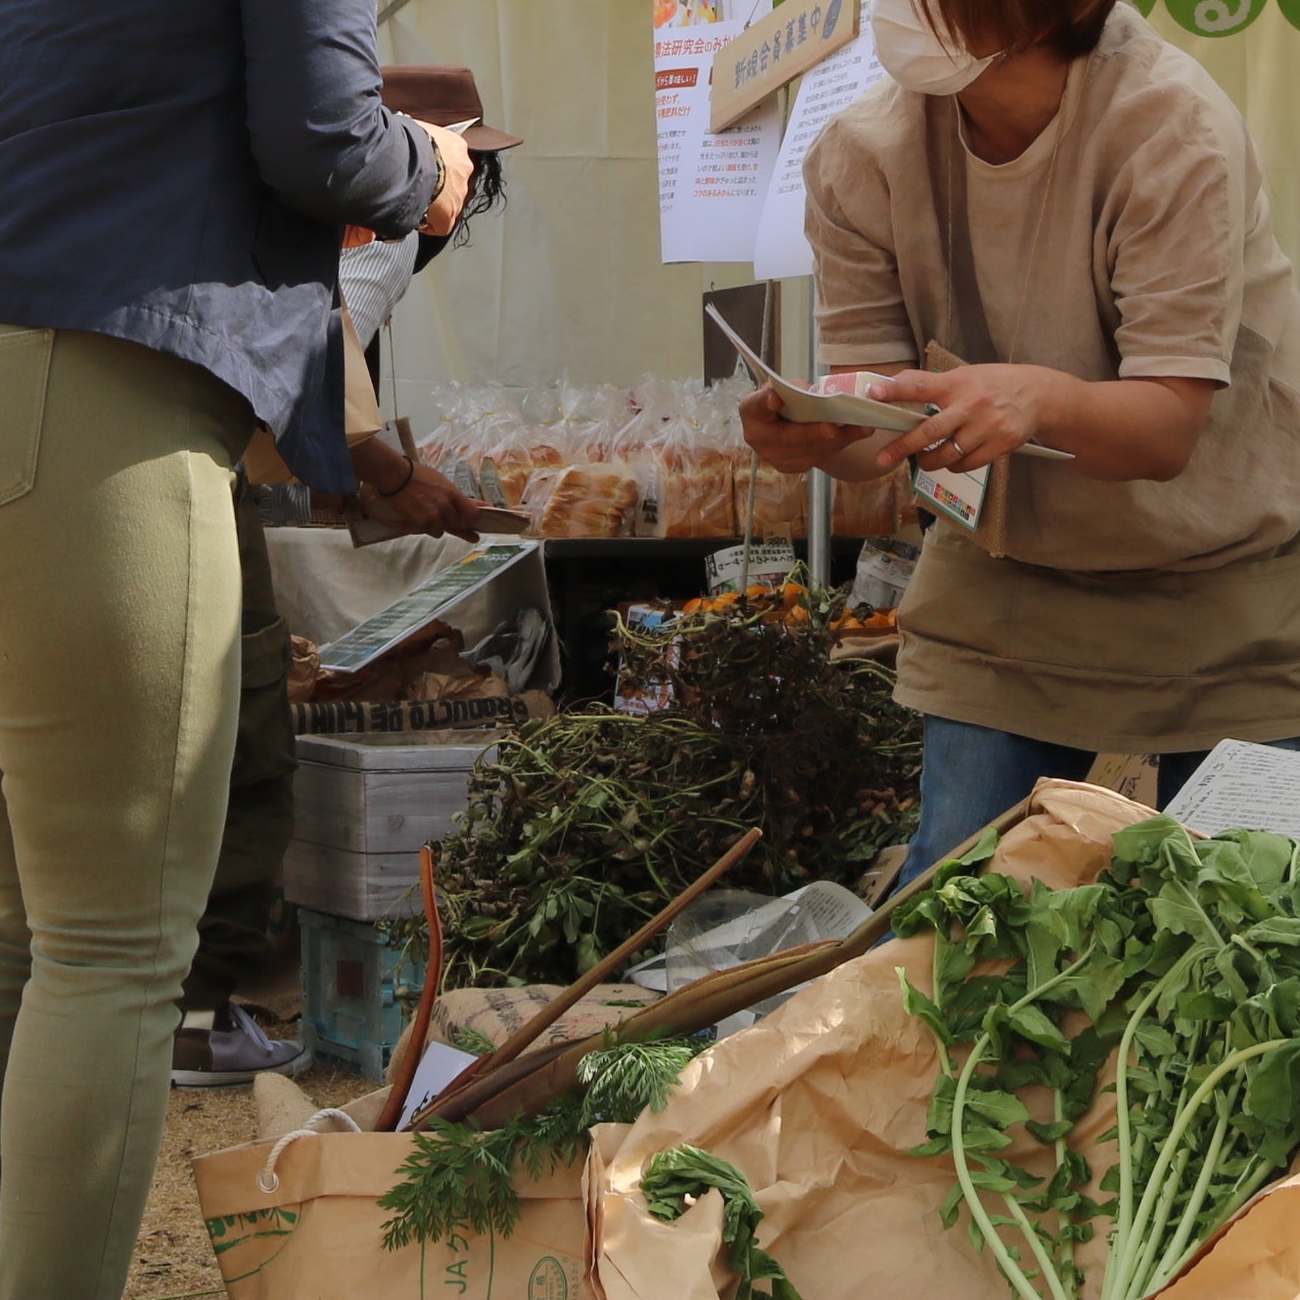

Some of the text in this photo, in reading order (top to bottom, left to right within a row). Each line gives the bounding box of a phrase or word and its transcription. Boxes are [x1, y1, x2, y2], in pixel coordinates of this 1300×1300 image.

[734, 3, 823, 91] 新規会員募集中
